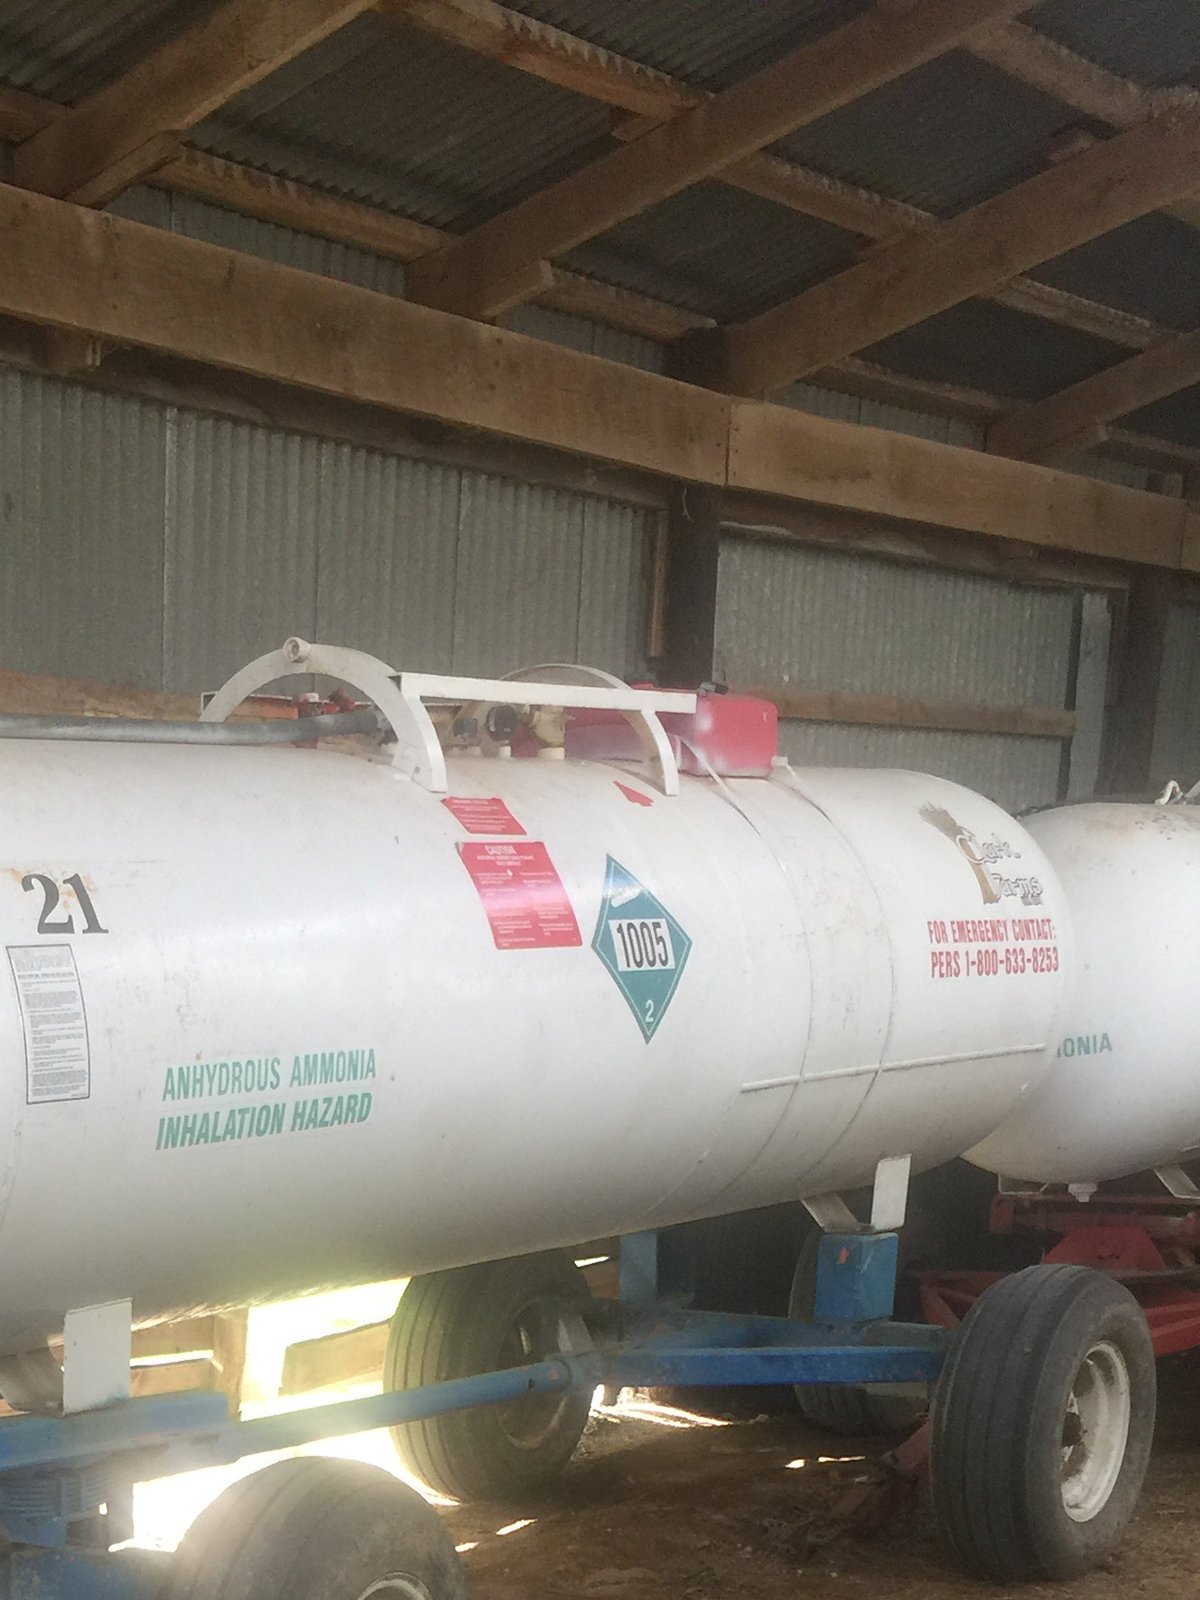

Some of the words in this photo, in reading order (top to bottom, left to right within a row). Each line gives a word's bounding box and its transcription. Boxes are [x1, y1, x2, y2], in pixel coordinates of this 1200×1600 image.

[20, 872, 110, 935] 21
[616, 921, 669, 968] 1005
[927, 920, 948, 943] FOR
[950, 918, 1009, 943] EMERGENCY
[1011, 917, 1057, 941] CONTACT:
[931, 950, 960, 978] PERS
[965, 946, 1059, 976] 1-800-633-8253
[645, 999, 655, 1023] 2
[162, 1056, 281, 1102] ANHYDROUS
[290, 1048, 376, 1088] AMMONIA
[155, 1102, 286, 1151] INHALATION
[290, 1092, 373, 1133] HAZARD
